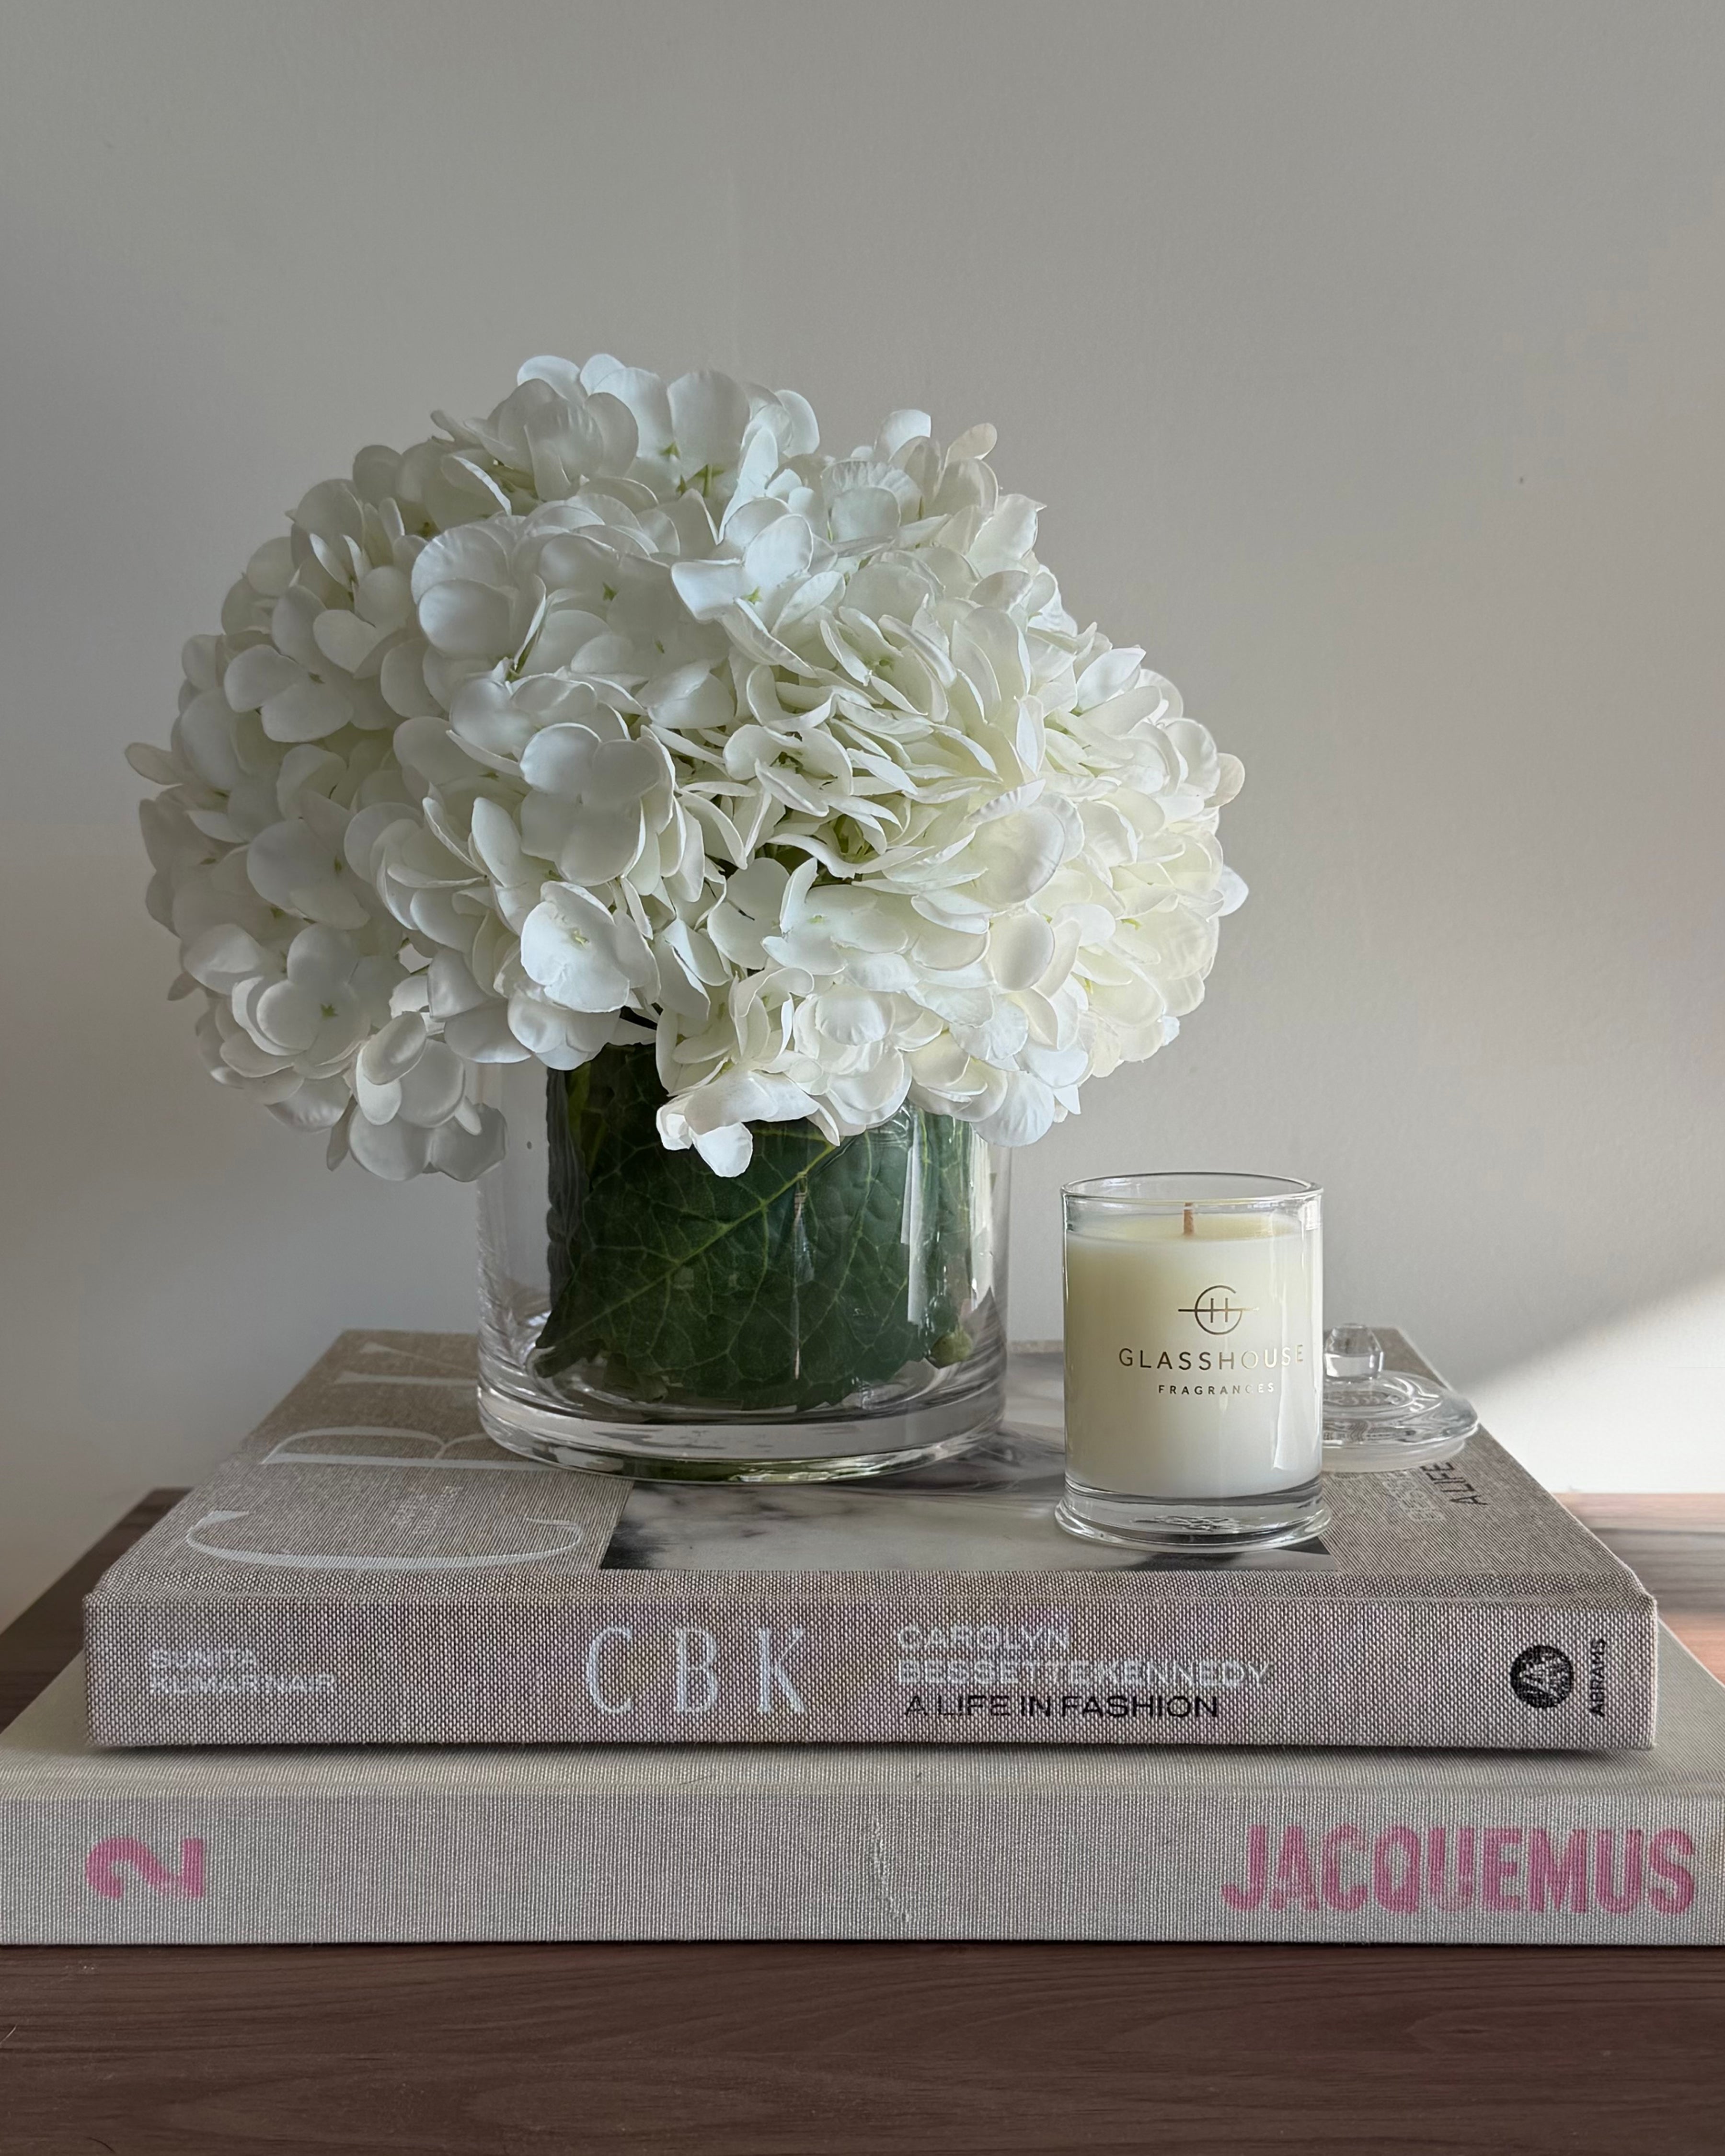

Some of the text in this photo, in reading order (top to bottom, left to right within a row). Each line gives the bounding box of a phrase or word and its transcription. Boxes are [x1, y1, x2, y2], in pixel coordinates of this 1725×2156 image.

[1118, 1344, 1303, 1371] GLASSHOUSE
[1158, 1382, 1274, 1395] FRAGRANCES
[1419, 1462, 1476, 1492] LIFE
[1376, 1471, 1449, 1521] BESSE
[897, 1625, 1070, 1651] CAROLYN
[150, 1648, 259, 1670] SUNITA
[149, 1673, 336, 1695] KUMAR NAIR
[897, 1659, 1273, 1688] BESSETTE KENNEDY
[1589, 1639, 1606, 1717] ABRAMS
[903, 1694, 1219, 1719] A LIFE IN FASHION
[85, 1836, 204, 1899] 2
[1221, 1824, 1696, 1916] JACQUEMUS
